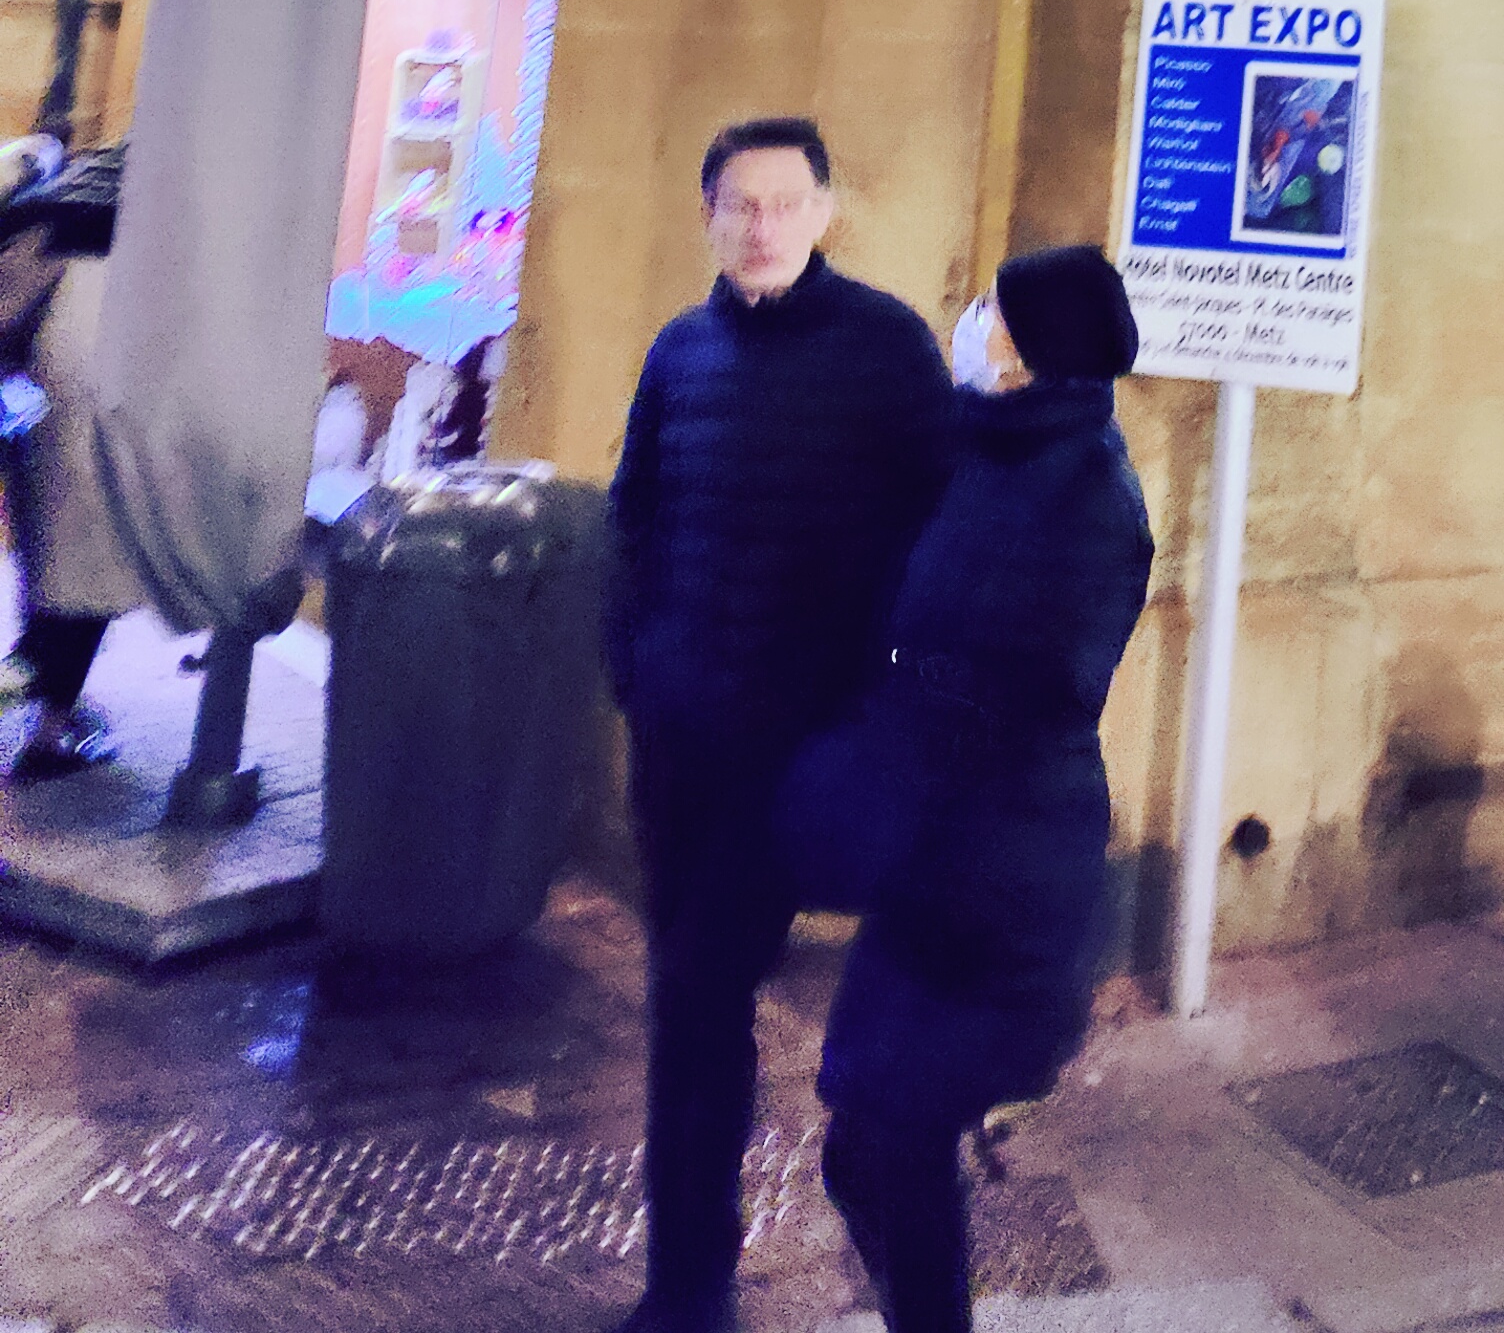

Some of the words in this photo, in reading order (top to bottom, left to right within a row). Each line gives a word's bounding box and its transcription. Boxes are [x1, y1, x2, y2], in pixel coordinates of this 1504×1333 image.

[1150, 0, 1235, 41] ART
[1249, 5, 1363, 49] EXPO
[1244, 260, 1291, 289] Metz
[1295, 264, 1355, 295] Centre
